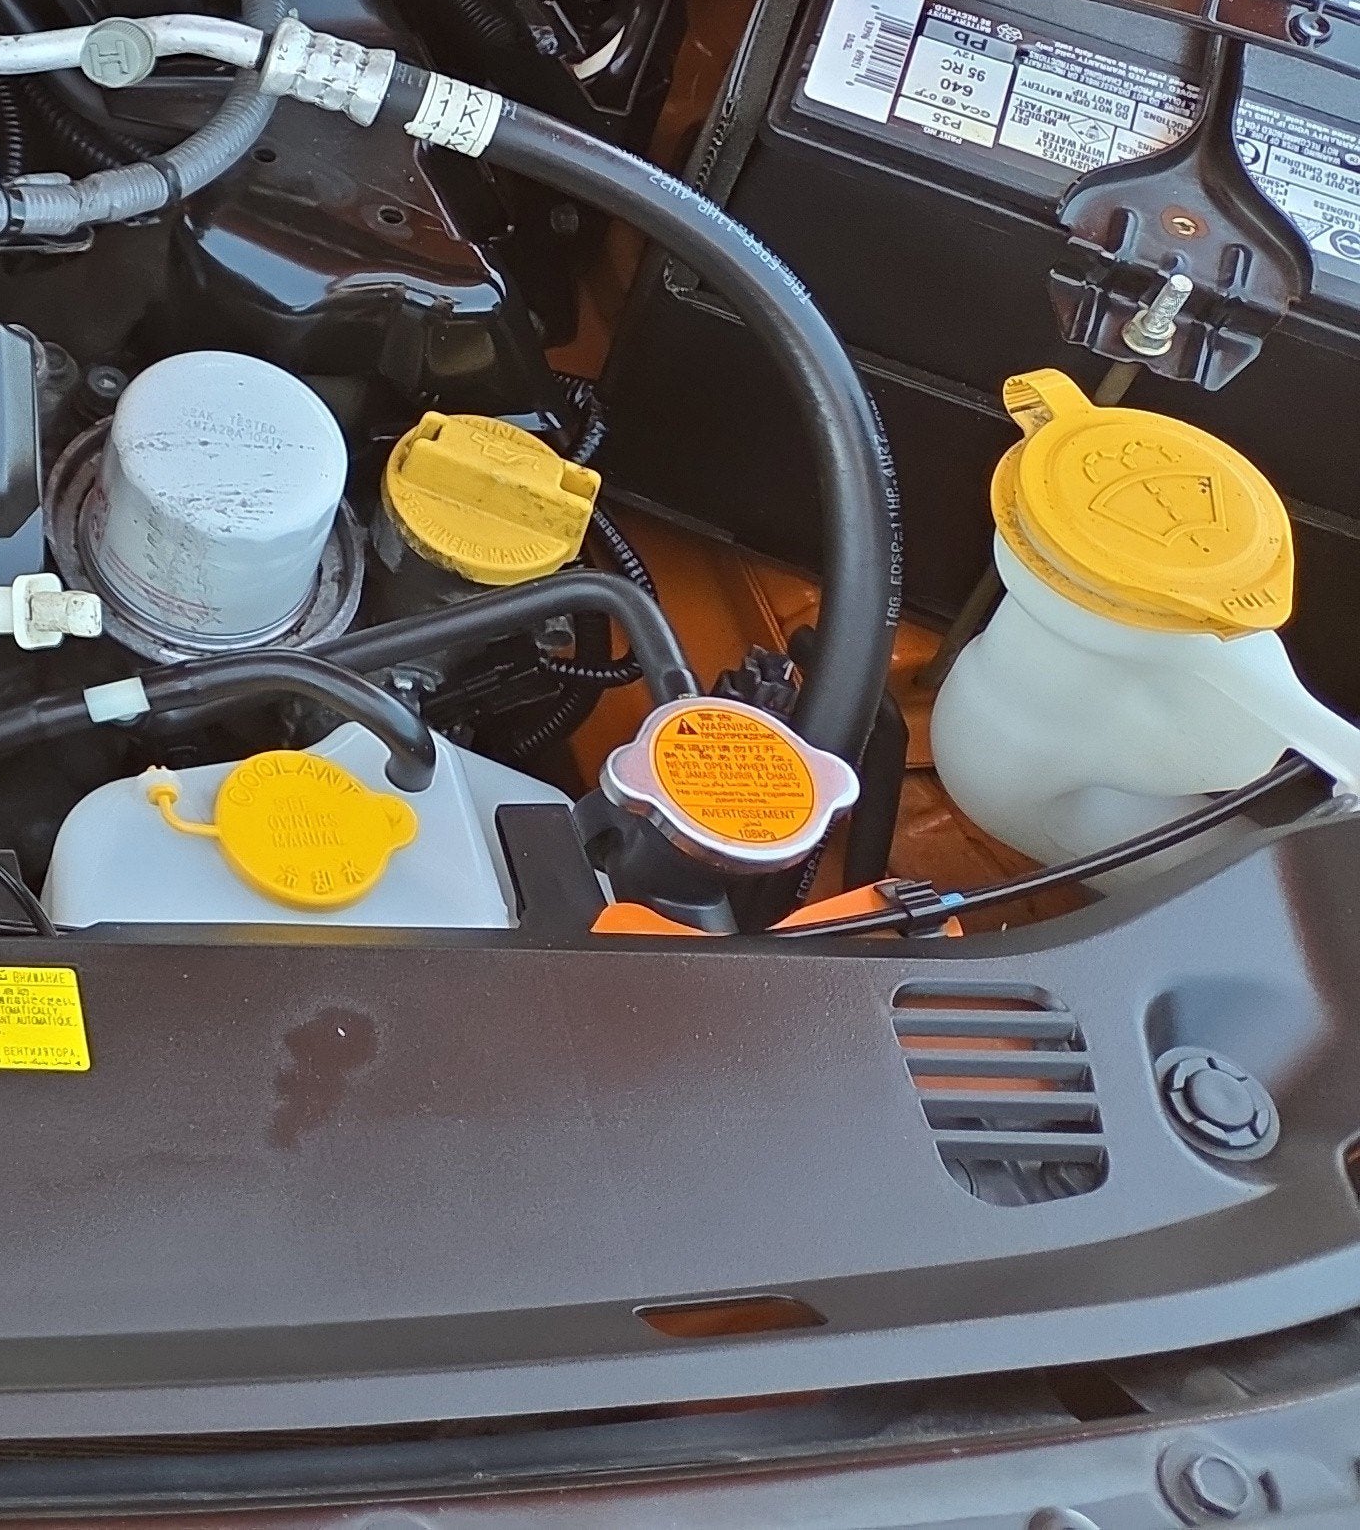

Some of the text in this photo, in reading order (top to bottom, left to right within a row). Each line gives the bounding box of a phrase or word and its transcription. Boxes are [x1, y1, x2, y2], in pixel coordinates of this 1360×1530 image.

[951, 29, 988, 51] Pb
[939, 58, 986, 81] 95 RC
[938, 76, 973, 97] 640
[1064, 92, 1091, 107] OPEN
[1091, 94, 1113, 106] NOT
[1011, 105, 1057, 126] MEDICAL
[1043, 107, 1071, 122] HELP
[1092, 102, 1112, 115] NOT
[930, 112, 962, 130] P35
[1078, 144, 1105, 158] WITH
[489, 541, 555, 565] MANUAL
[1221, 587, 1283, 616] PULL
[698, 722, 759, 732] WARNING
[666, 760, 701, 771] NEVER
[704, 761, 733, 771] OPEN
[736, 762, 769, 772] WHEN
[228, 757, 362, 806] COOLANT
[274, 795, 307, 811] SEE
[702, 808, 796, 819] AVERTISSEMENT
[272, 830, 344, 848] MANUAL
[738, 829, 777, 841] 108kPa
